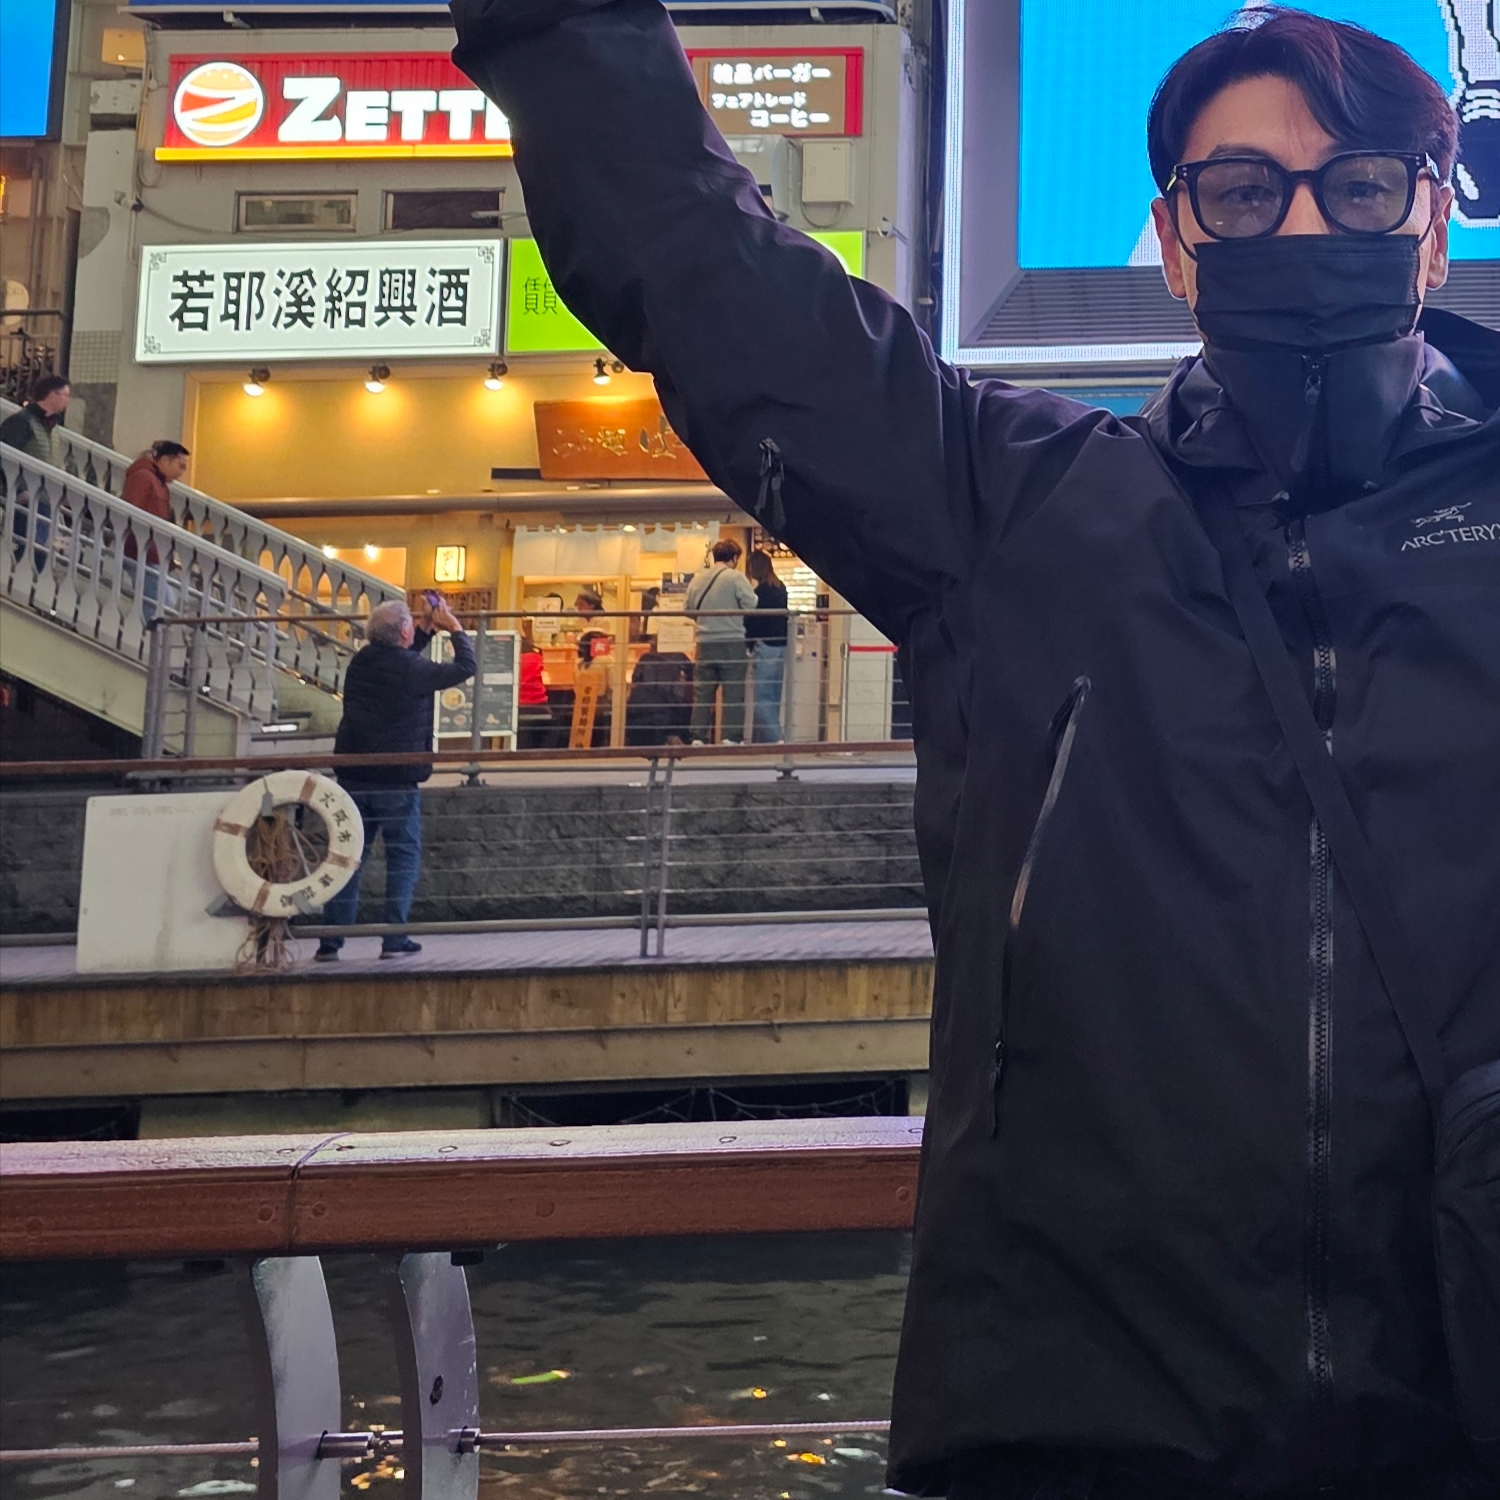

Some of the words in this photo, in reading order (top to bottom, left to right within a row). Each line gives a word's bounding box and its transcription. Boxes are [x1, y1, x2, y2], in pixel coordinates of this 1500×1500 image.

[711, 90, 807, 109] フェアトレード
[750, 107, 831, 129] コーヒー
